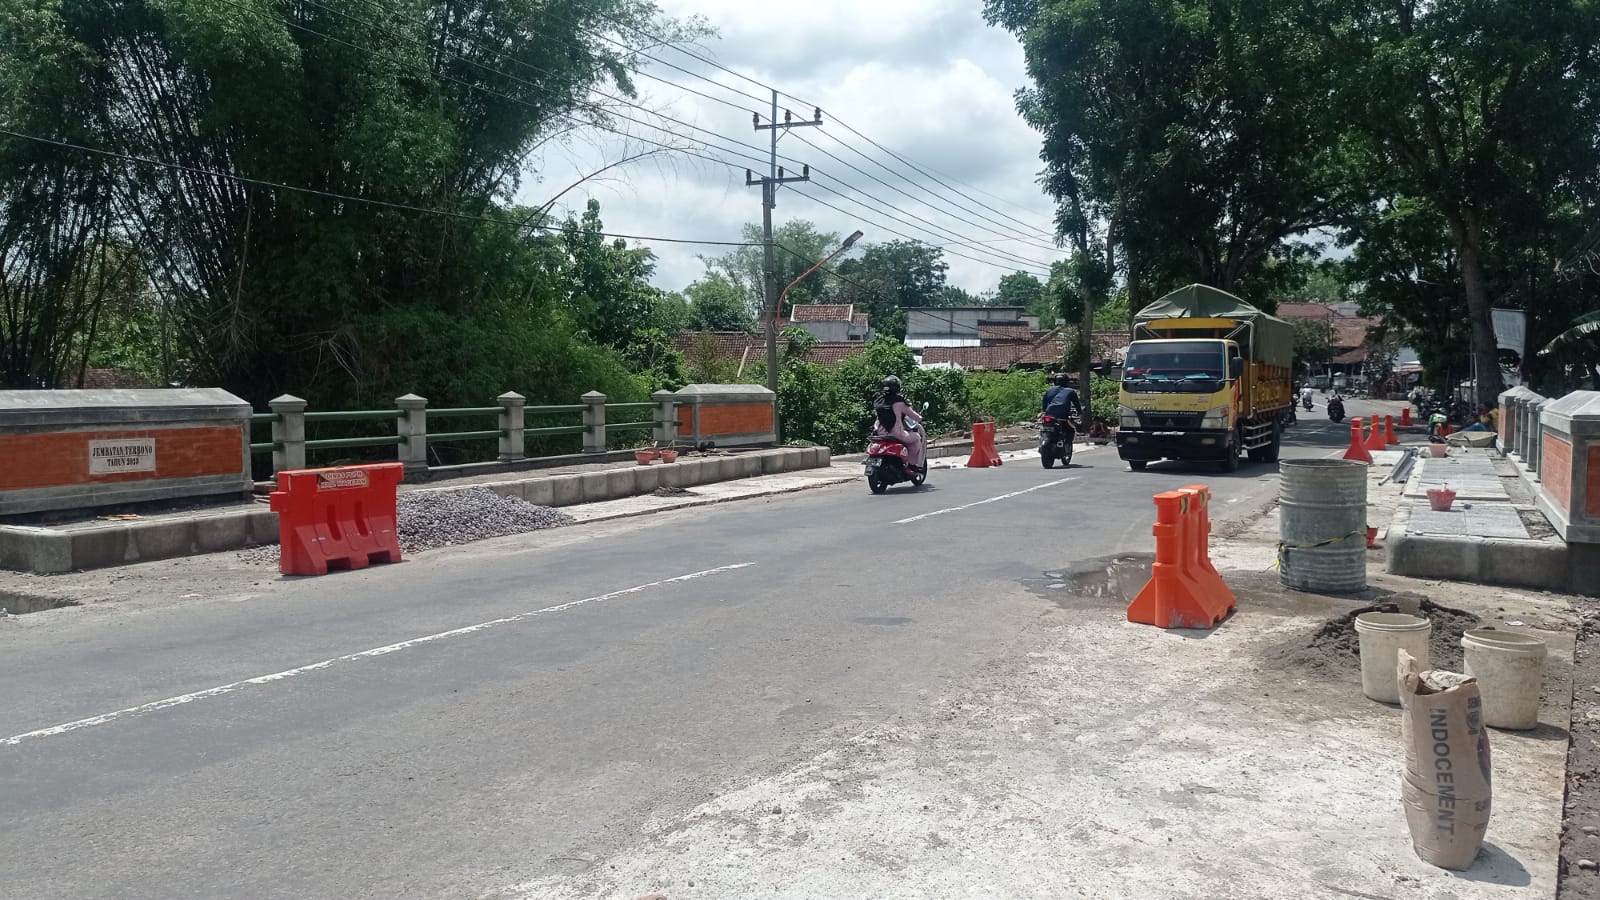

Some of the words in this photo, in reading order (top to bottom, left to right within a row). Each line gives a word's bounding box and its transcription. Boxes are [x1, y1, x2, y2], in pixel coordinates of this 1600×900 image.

[93, 446, 124, 456] JEMBATAN
[107, 458, 125, 466] TAHUN
[127, 458, 139, 466] 2023
[1430, 708, 1456, 835] INDOCEMENT
